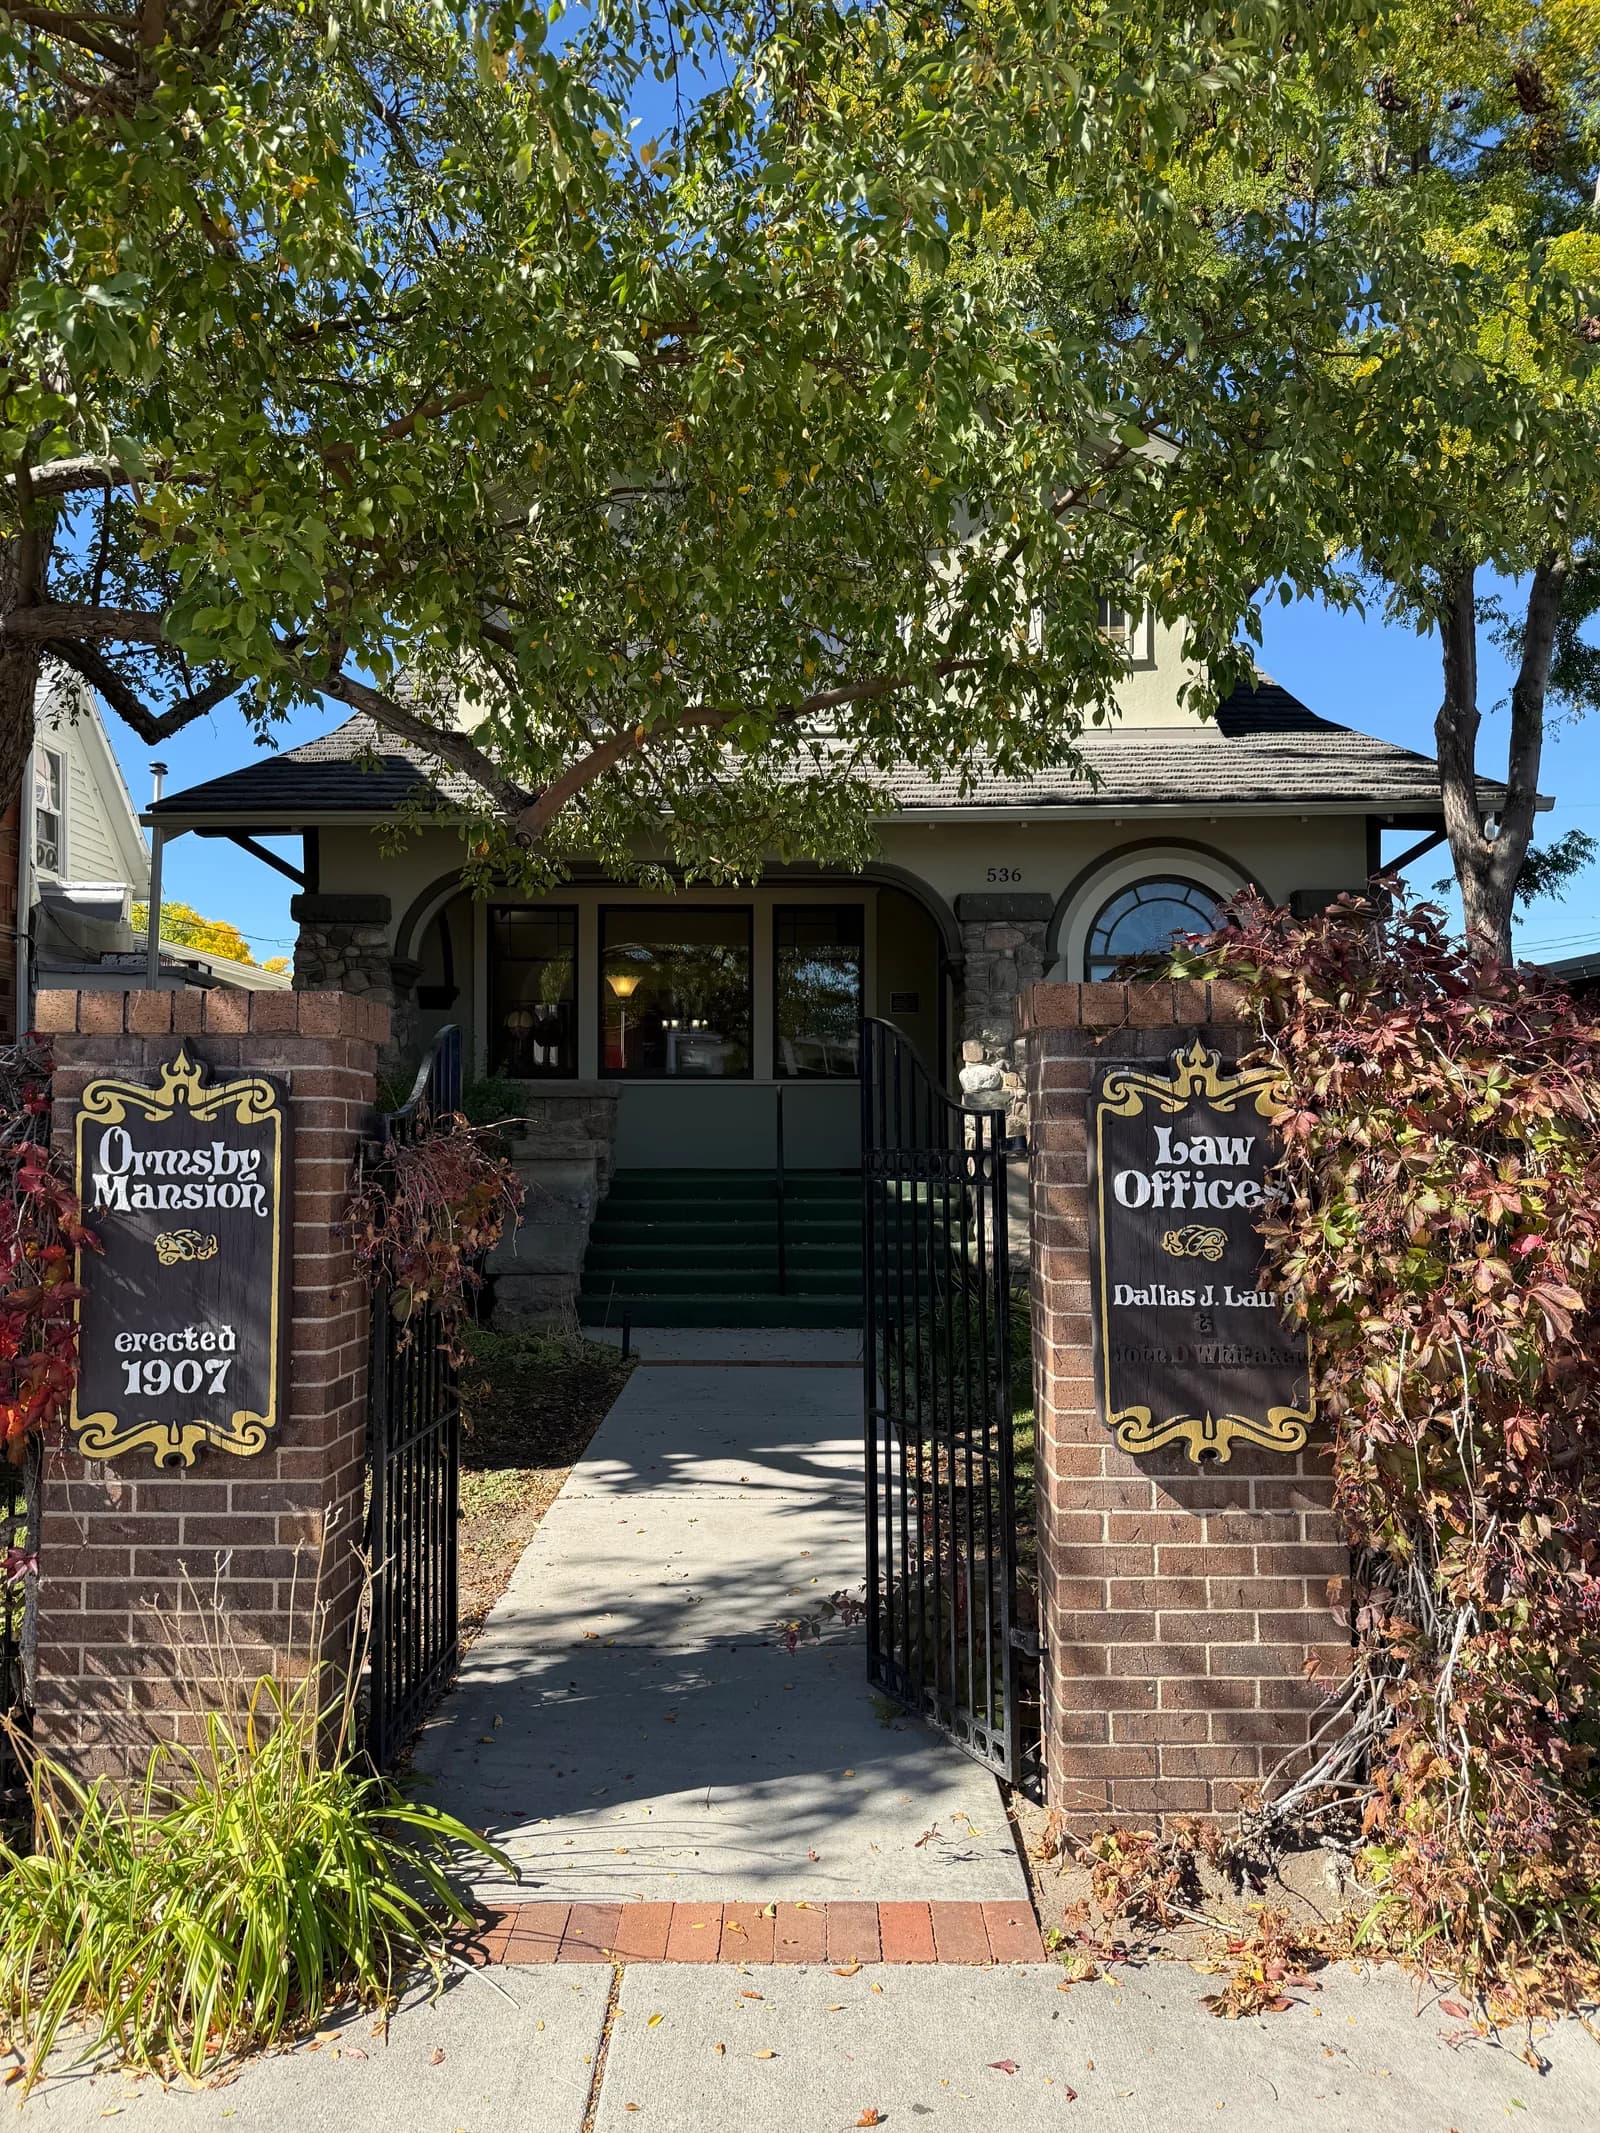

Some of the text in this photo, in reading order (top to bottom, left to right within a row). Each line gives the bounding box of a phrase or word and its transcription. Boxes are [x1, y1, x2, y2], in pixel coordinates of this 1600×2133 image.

[986, 867, 1022, 883] 536
[99, 1125, 261, 1182] Ormsby
[1153, 1125, 1256, 1166] Law
[88, 1173, 268, 1216] Mansion
[1113, 1284, 1196, 1307] Dallas
[1200, 1285, 1220, 1307] J.
[114, 1325, 237, 1353] erected
[120, 1358, 232, 1397] 1907
